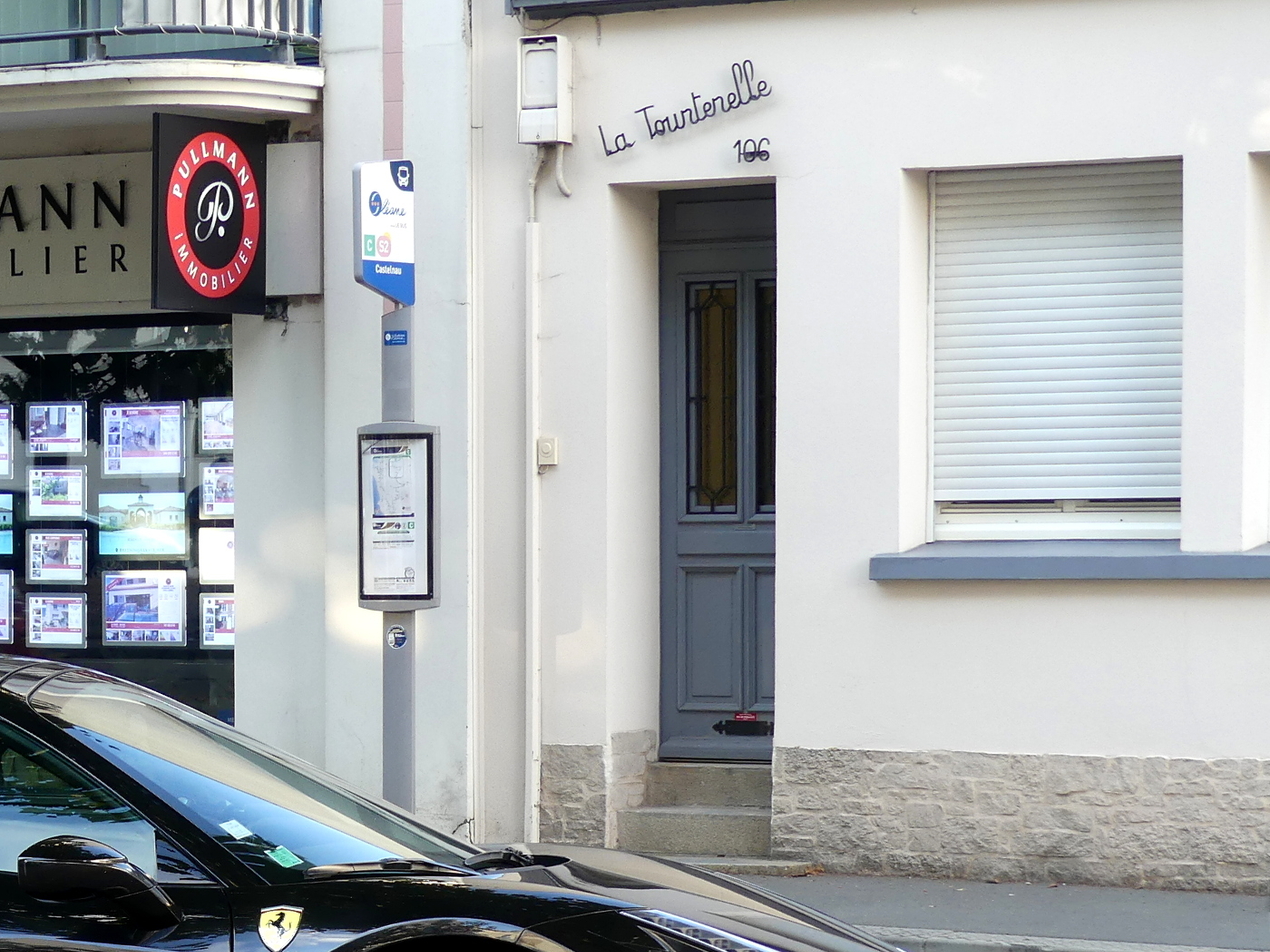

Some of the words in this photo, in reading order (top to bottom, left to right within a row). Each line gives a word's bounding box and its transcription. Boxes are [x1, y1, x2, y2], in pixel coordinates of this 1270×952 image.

[597, 124, 637, 156] La
[634, 59, 773, 140] Tourterelle
[733, 137, 771, 163] 106
[171, 139, 256, 210] PULLMANN
[366, 239, 373, 252] C
[378, 240, 390, 254] S2
[173, 232, 253, 291] IMMOBILIER
[375, 263, 402, 276] Castelnau
